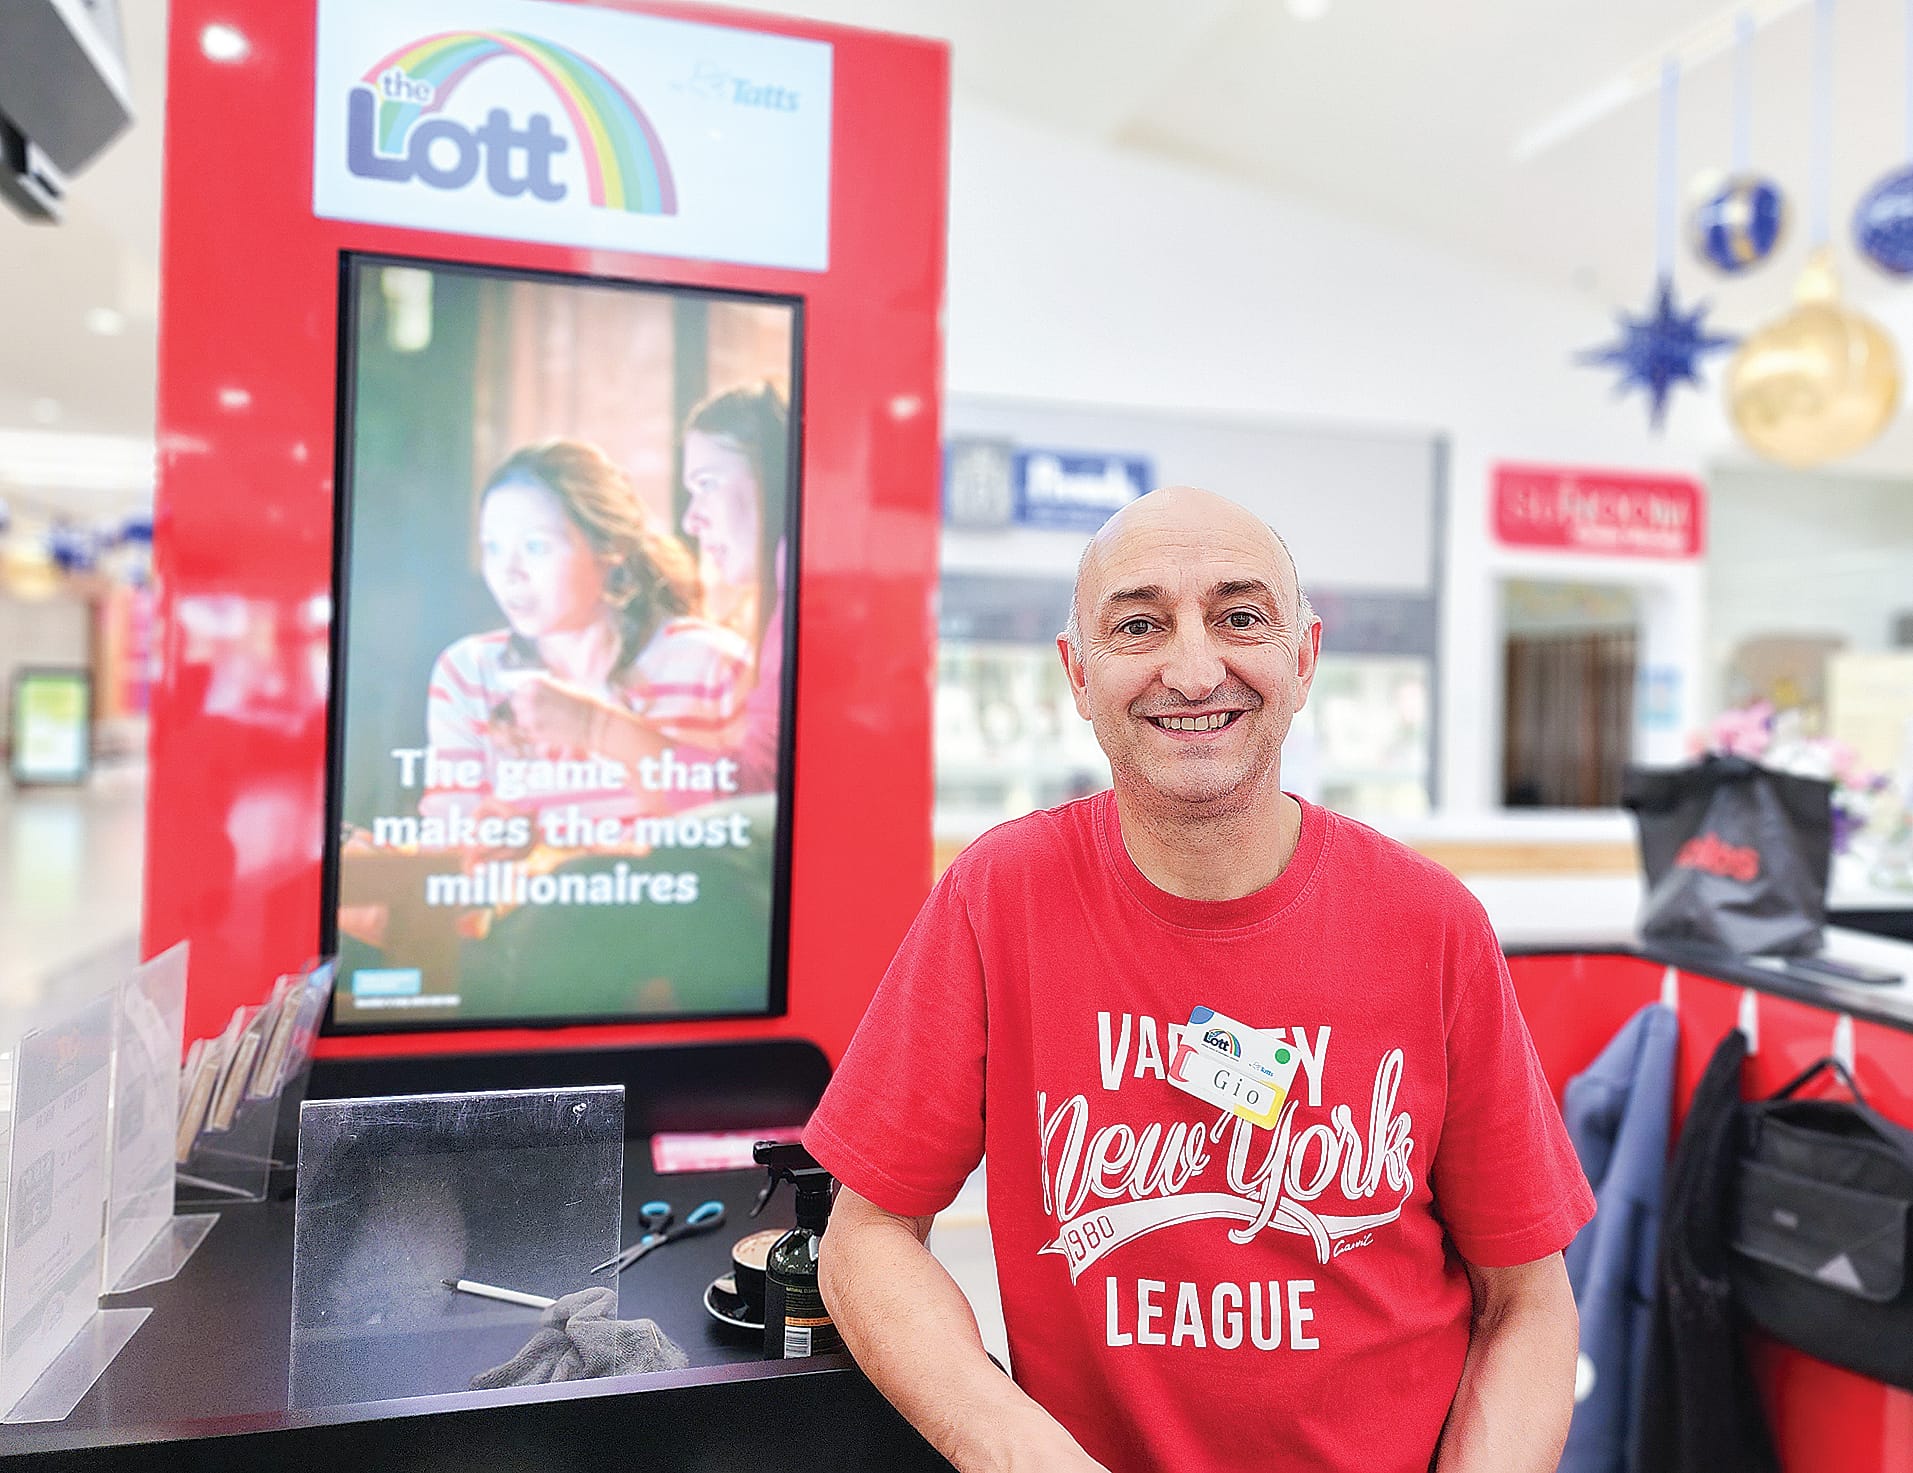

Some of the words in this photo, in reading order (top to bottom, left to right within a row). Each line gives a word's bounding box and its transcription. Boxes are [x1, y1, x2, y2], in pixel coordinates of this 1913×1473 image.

[383, 72, 431, 101] the
[731, 78, 800, 112] Tatts
[347, 87, 567, 202] Lott
[391, 749, 480, 788] The
[495, 757, 625, 800] game
[638, 749, 738, 792] that
[374, 808, 529, 847] makes
[539, 806, 622, 846] the
[637, 812, 751, 847] most
[426, 862, 698, 905] millionaires
[1037, 1091, 1211, 1223] New
[1210, 1048, 1414, 1245] York
[1063, 1215, 1115, 1268] 1980
[1106, 1276, 1319, 1351] LEAGUE
